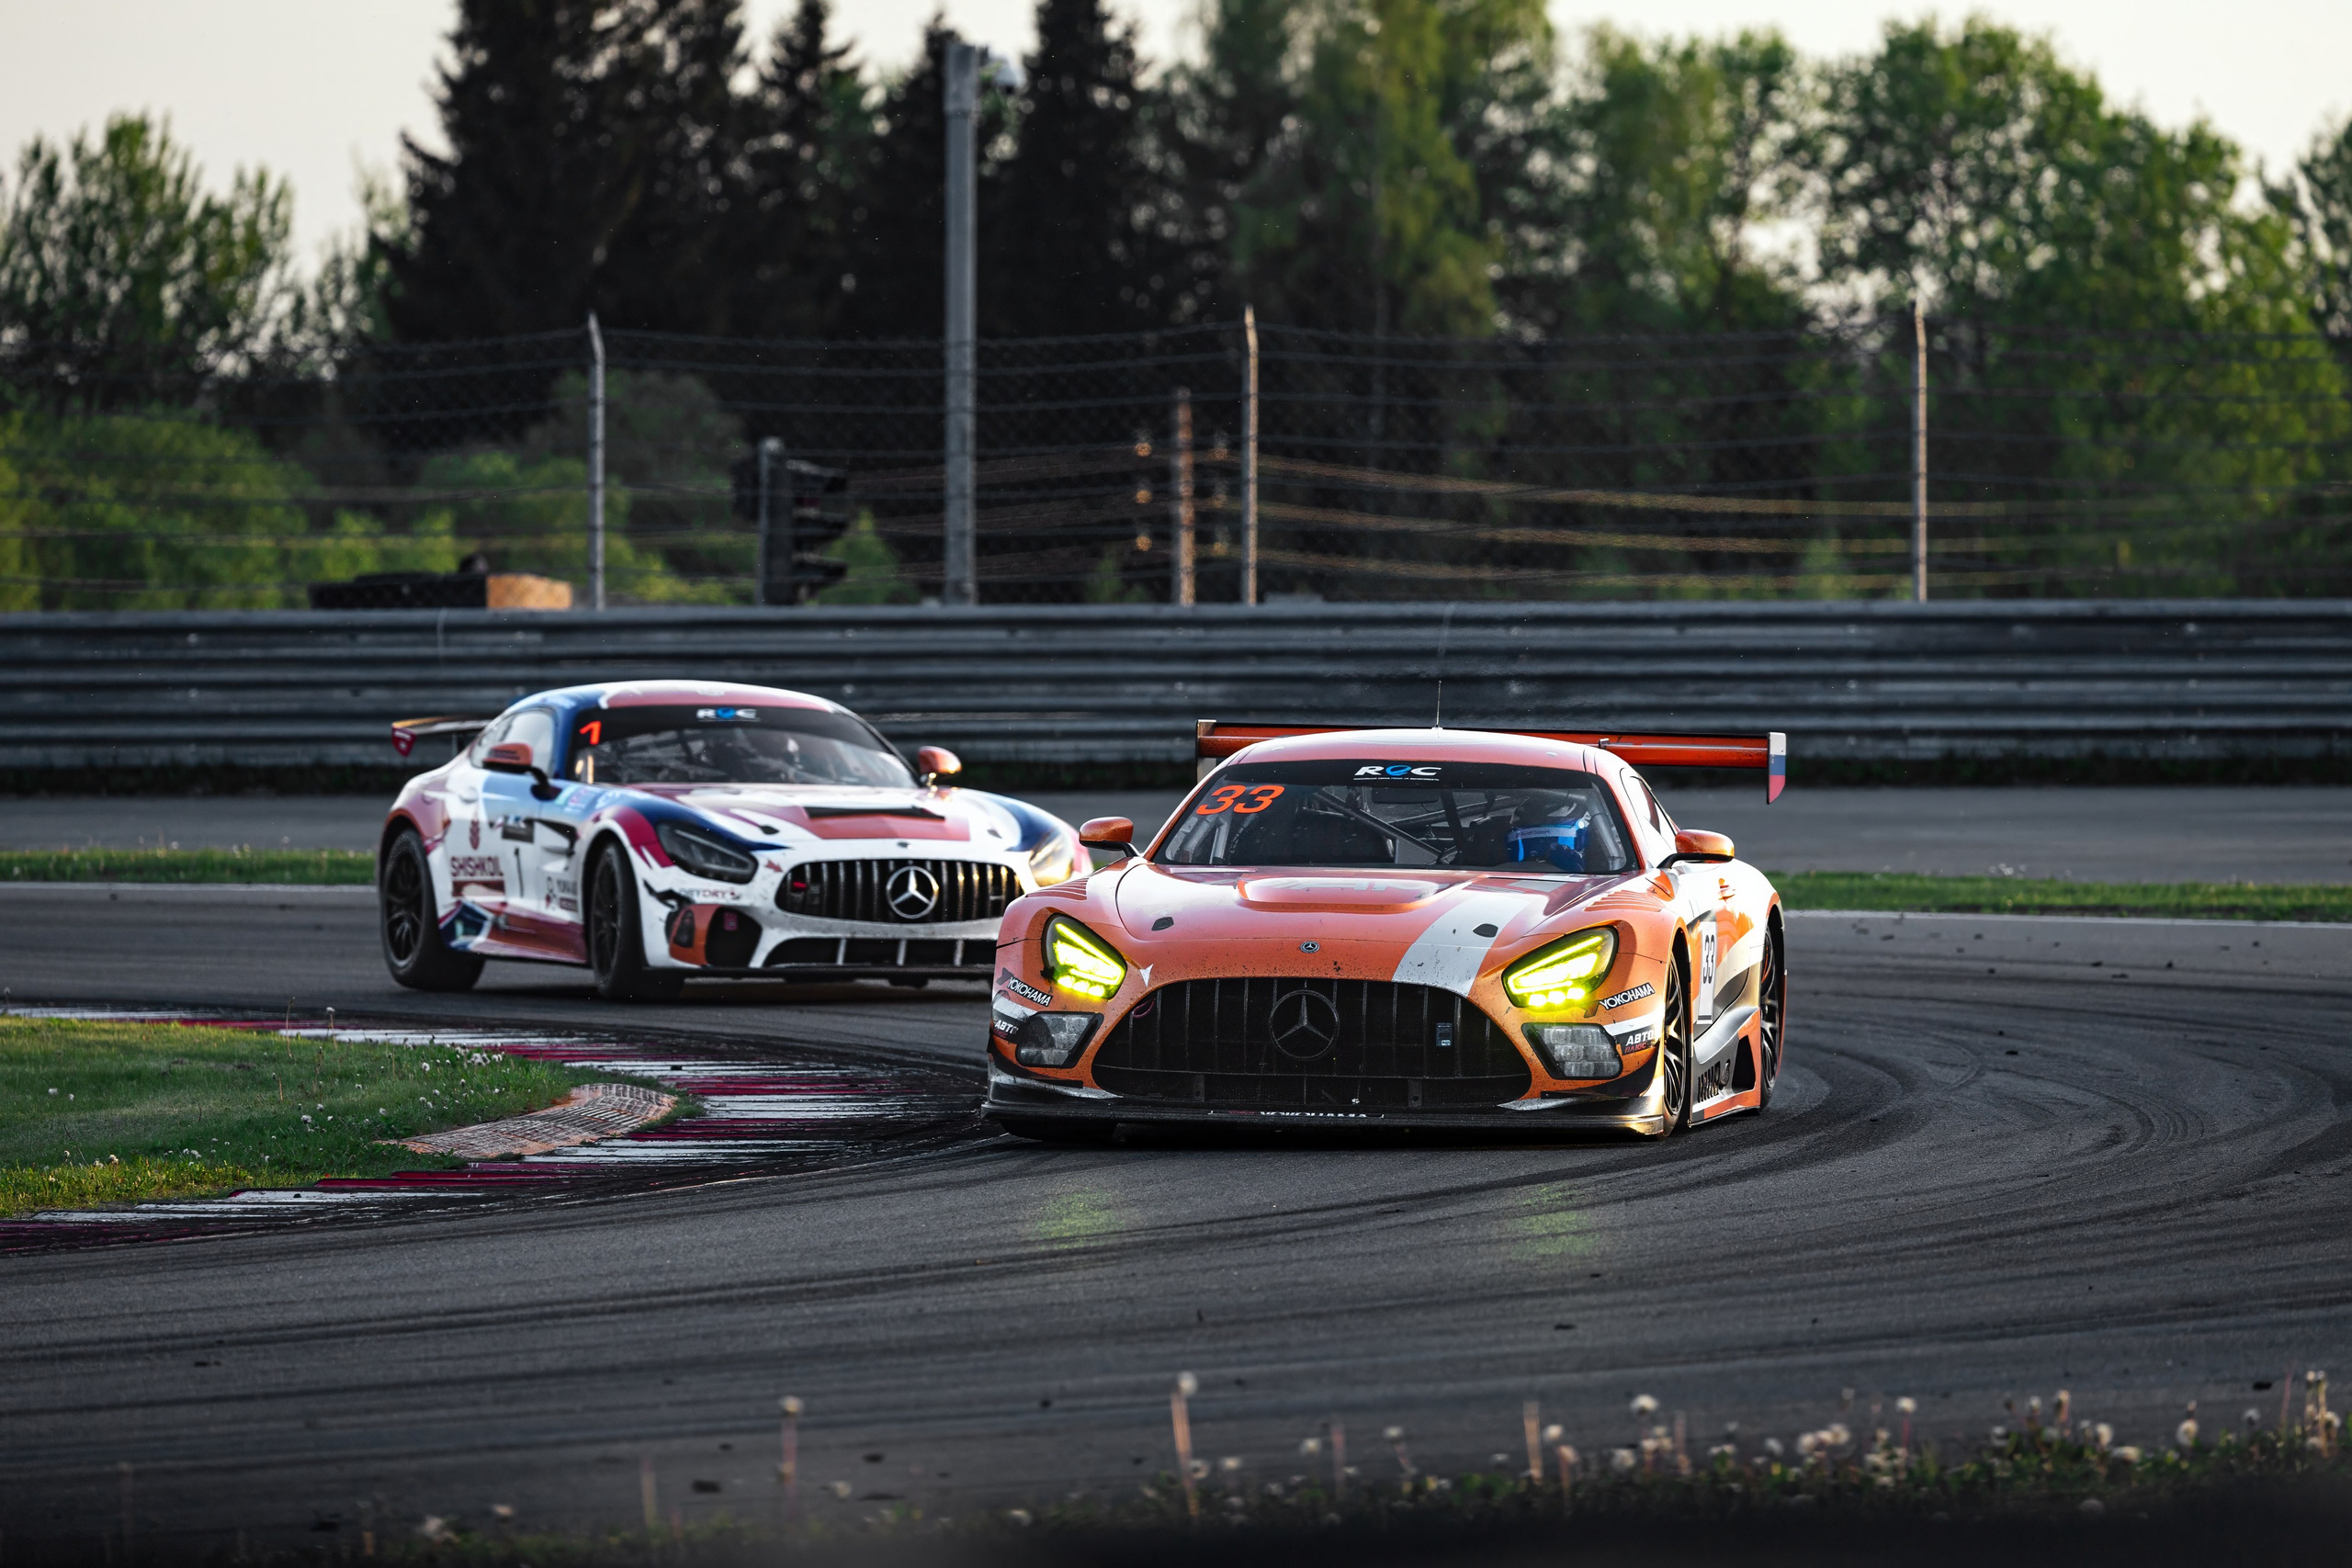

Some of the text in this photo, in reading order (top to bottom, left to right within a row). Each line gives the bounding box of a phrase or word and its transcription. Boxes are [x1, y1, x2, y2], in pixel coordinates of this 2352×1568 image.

[579, 721, 602, 745] 1
[1195, 784, 1285, 816] 33
[1702, 934, 1715, 985] 33
[1007, 976, 1052, 1007] YOKOHAMA
[1599, 983, 1655, 1010] YOKOHAMA
